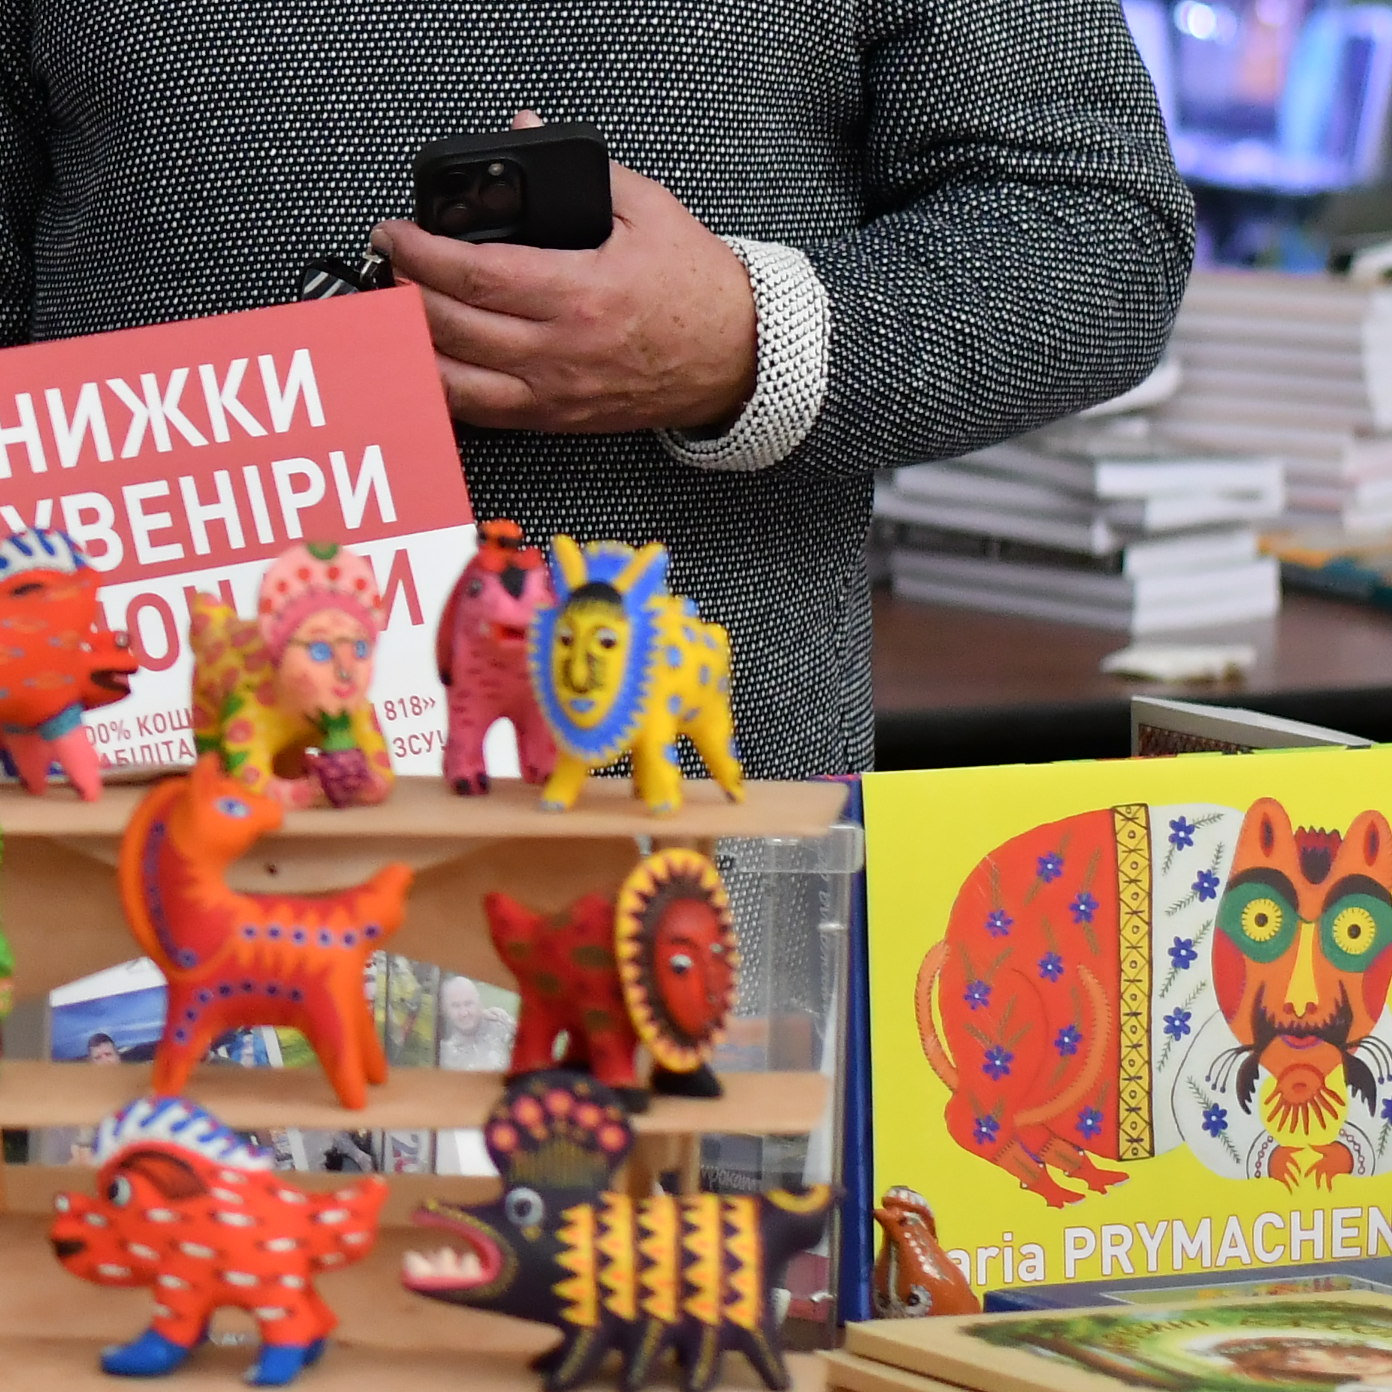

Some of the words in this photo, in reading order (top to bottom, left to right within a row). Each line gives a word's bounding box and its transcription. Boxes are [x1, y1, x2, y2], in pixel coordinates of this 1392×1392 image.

[393, 729, 445, 759] ЗСУ!
[947, 1230, 1046, 1287] aria
[1063, 1205, 1392, 1280] PRYMACHEN
